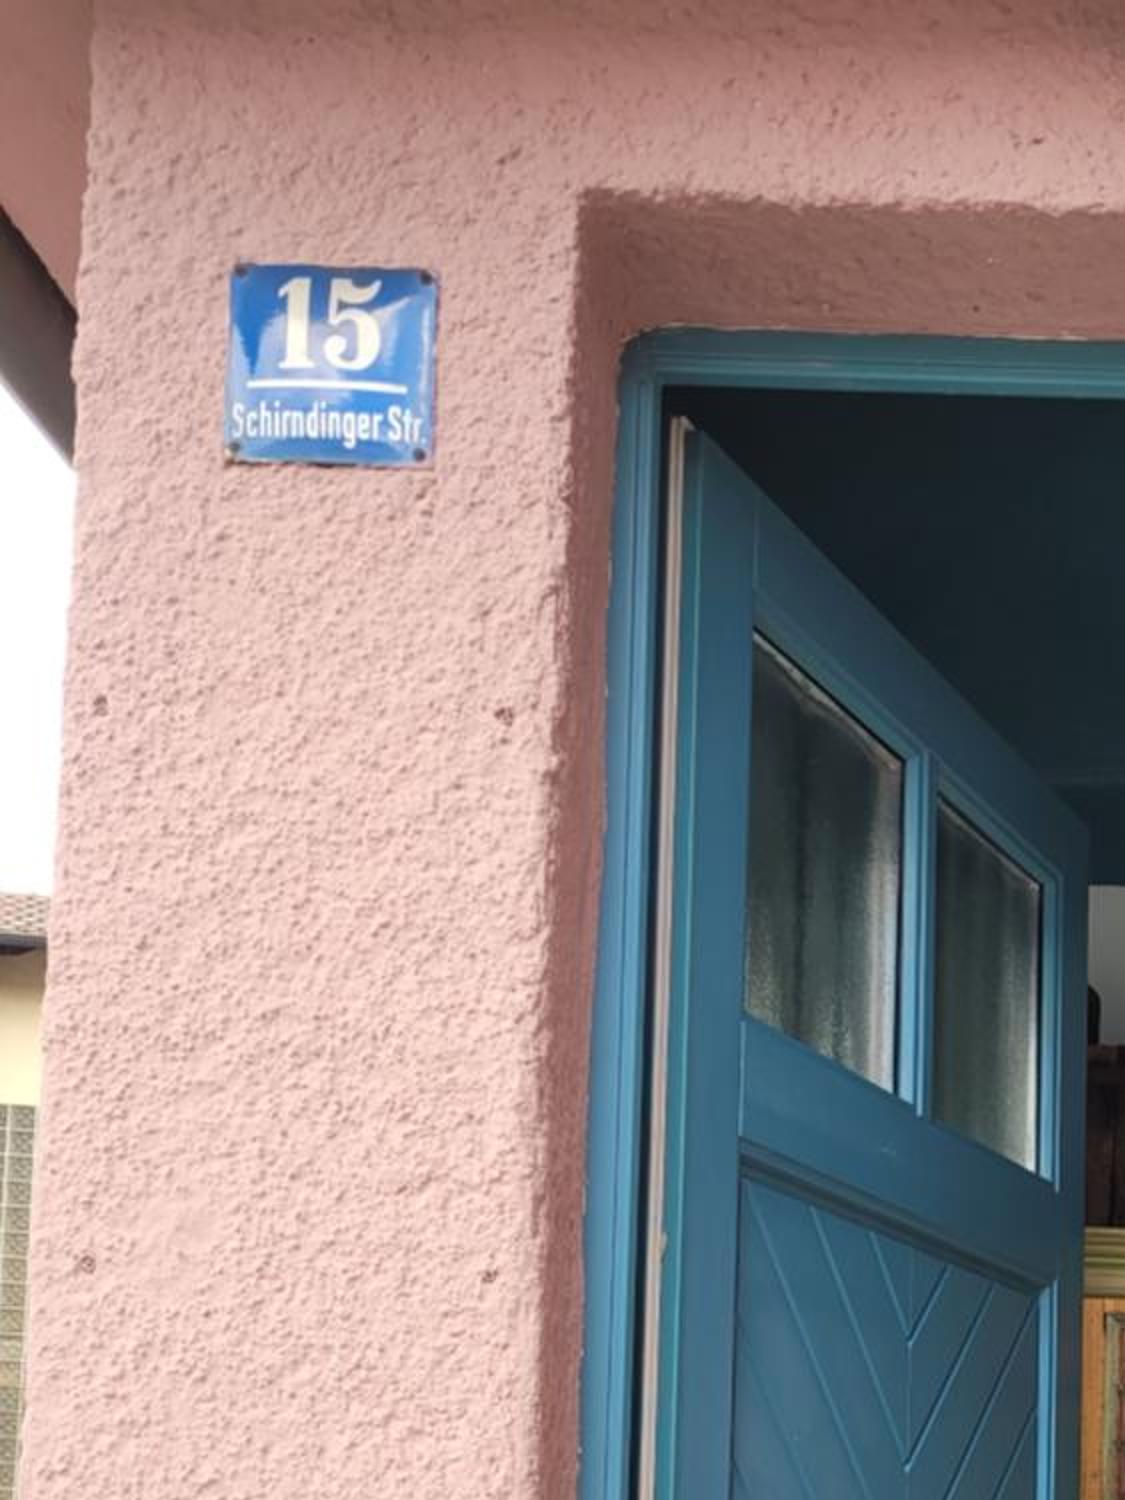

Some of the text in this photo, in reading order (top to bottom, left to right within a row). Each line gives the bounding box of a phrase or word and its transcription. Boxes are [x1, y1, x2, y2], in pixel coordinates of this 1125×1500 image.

[277, 276, 382, 371] 15
[232, 400, 427, 449] Schirndinger Str.
